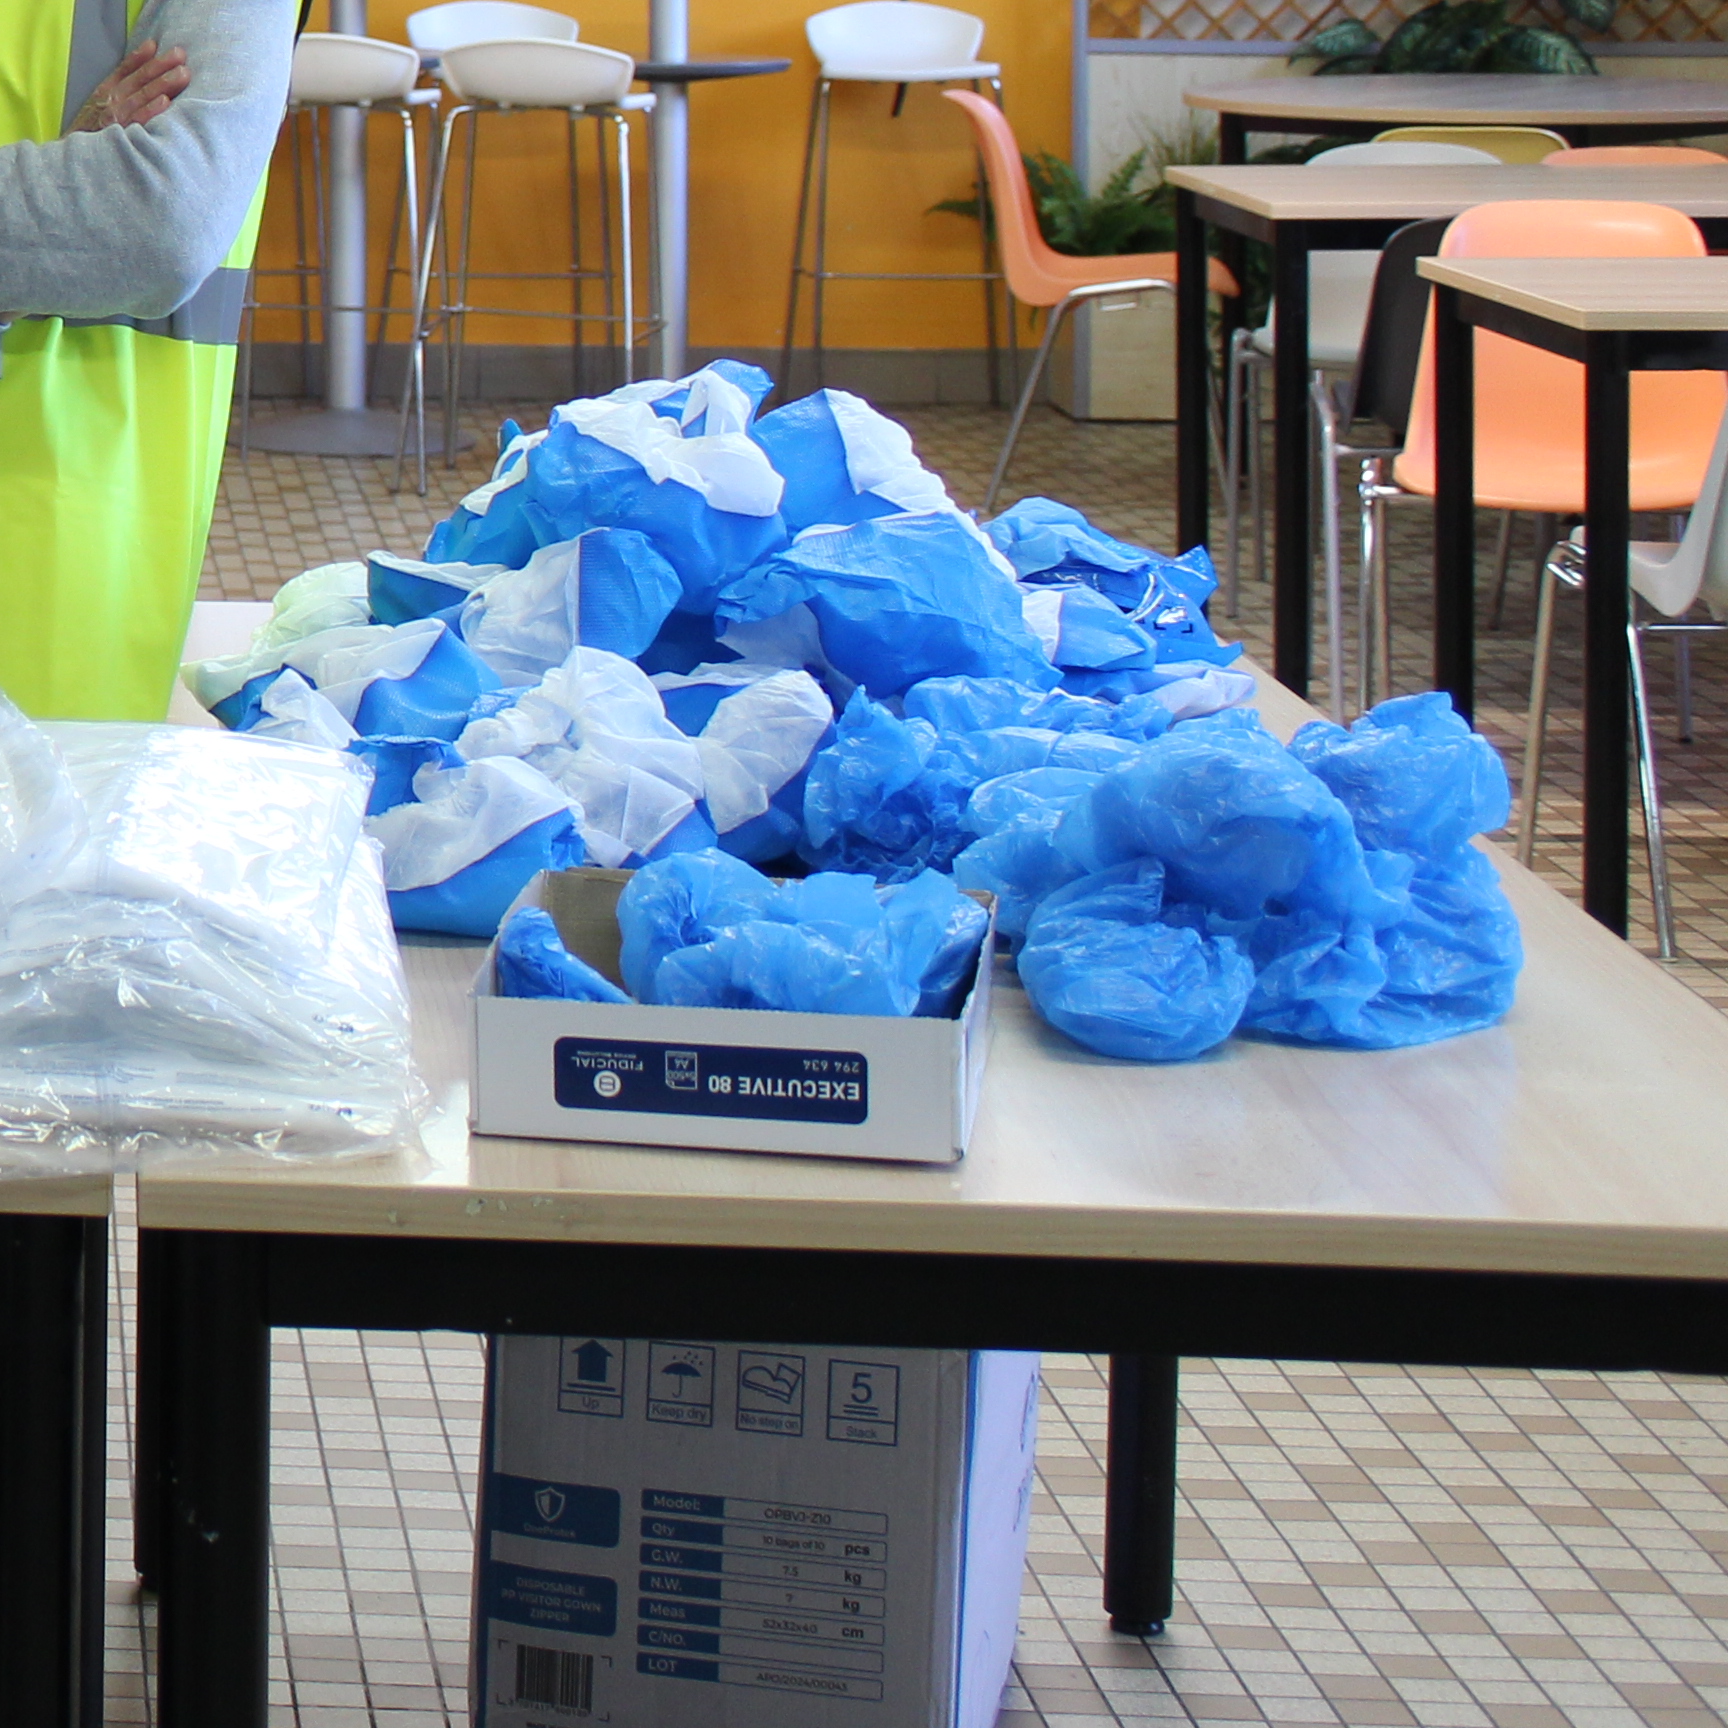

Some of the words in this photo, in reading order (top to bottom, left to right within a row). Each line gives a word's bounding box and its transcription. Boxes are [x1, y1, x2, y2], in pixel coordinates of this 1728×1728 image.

[571, 1056, 644, 1071] FIDUCIAL
[802, 1059, 829, 1072] 634
[834, 1060, 861, 1073] 294
[709, 1074, 732, 1093] 80
[738, 1076, 861, 1101] EXECUTIVE
[850, 1372, 873, 1404] 5
[580, 1396, 600, 1411] Up
[651, 1403, 681, 1420] Keep
[683, 1406, 708, 1423] dry
[739, 1412, 756, 1425] No
[758, 1414, 783, 1430] step
[784, 1419, 799, 1430] on
[845, 1426, 877, 1441] Stack
[653, 1494, 701, 1512] Model:
[652, 1522, 676, 1538] Qty
[762, 1535, 773, 1547] 10
[813, 1540, 826, 1552] 10
[844, 1543, 871, 1558] pcs
[651, 1549, 683, 1564] G.W.
[844, 1570, 862, 1586] kg
[516, 1576, 586, 1598] DISPOSABLE
[650, 1577, 683, 1592] N.W.
[842, 1597, 860, 1613] kg
[517, 1590, 562, 1608] VISITOR
[563, 1597, 602, 1614] GOWN
[529, 1607, 571, 1623] ZIPPER
[650, 1604, 687, 1620] Meas
[841, 1625, 865, 1639] cm
[648, 1657, 678, 1673] LOT
